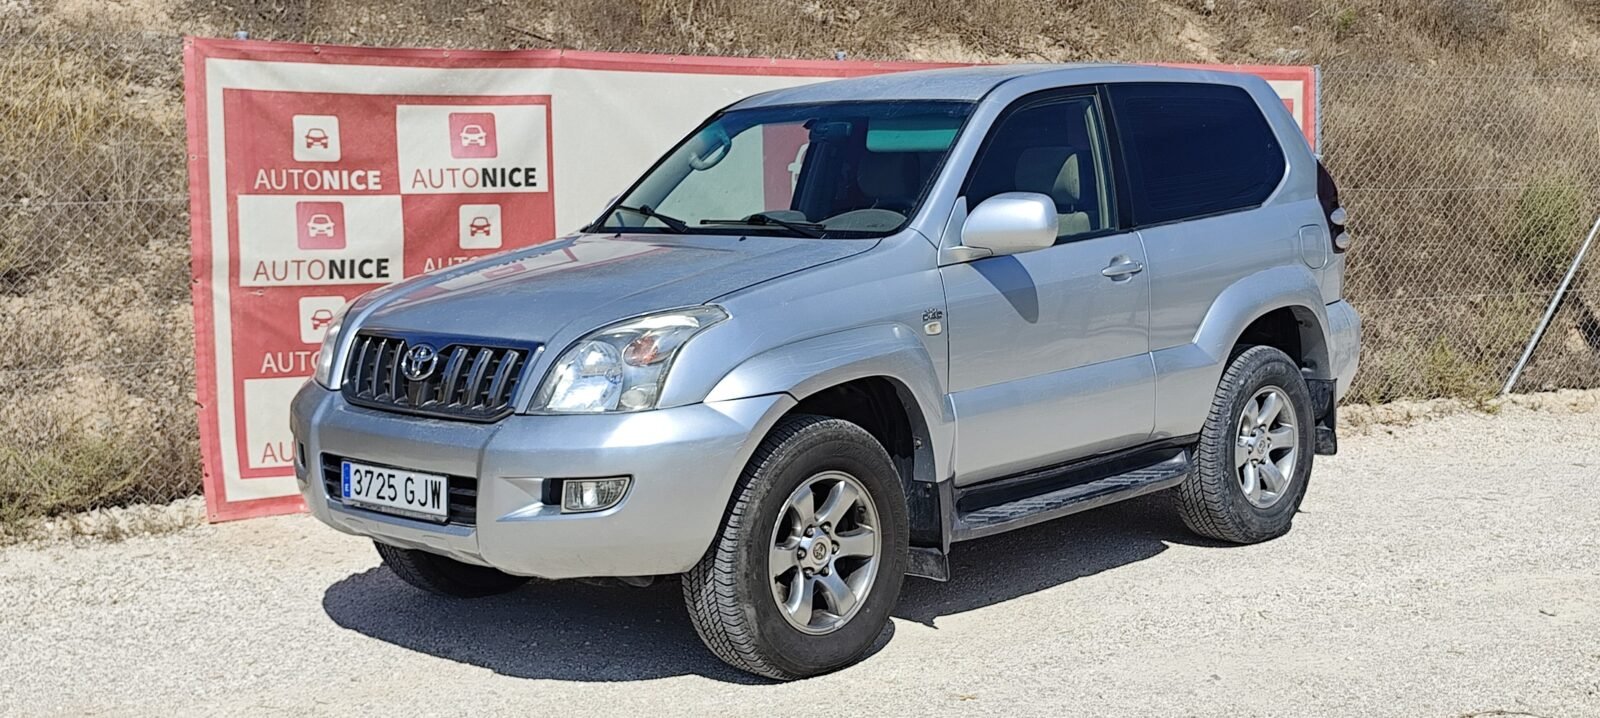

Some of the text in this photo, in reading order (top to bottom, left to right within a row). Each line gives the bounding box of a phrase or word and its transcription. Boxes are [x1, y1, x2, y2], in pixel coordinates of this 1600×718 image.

[254, 168, 382, 190] AUTONICE
[412, 167, 537, 189] AUTONICE
[253, 258, 390, 281] AUTONICE
[353, 468, 441, 510] 3725 GJW
